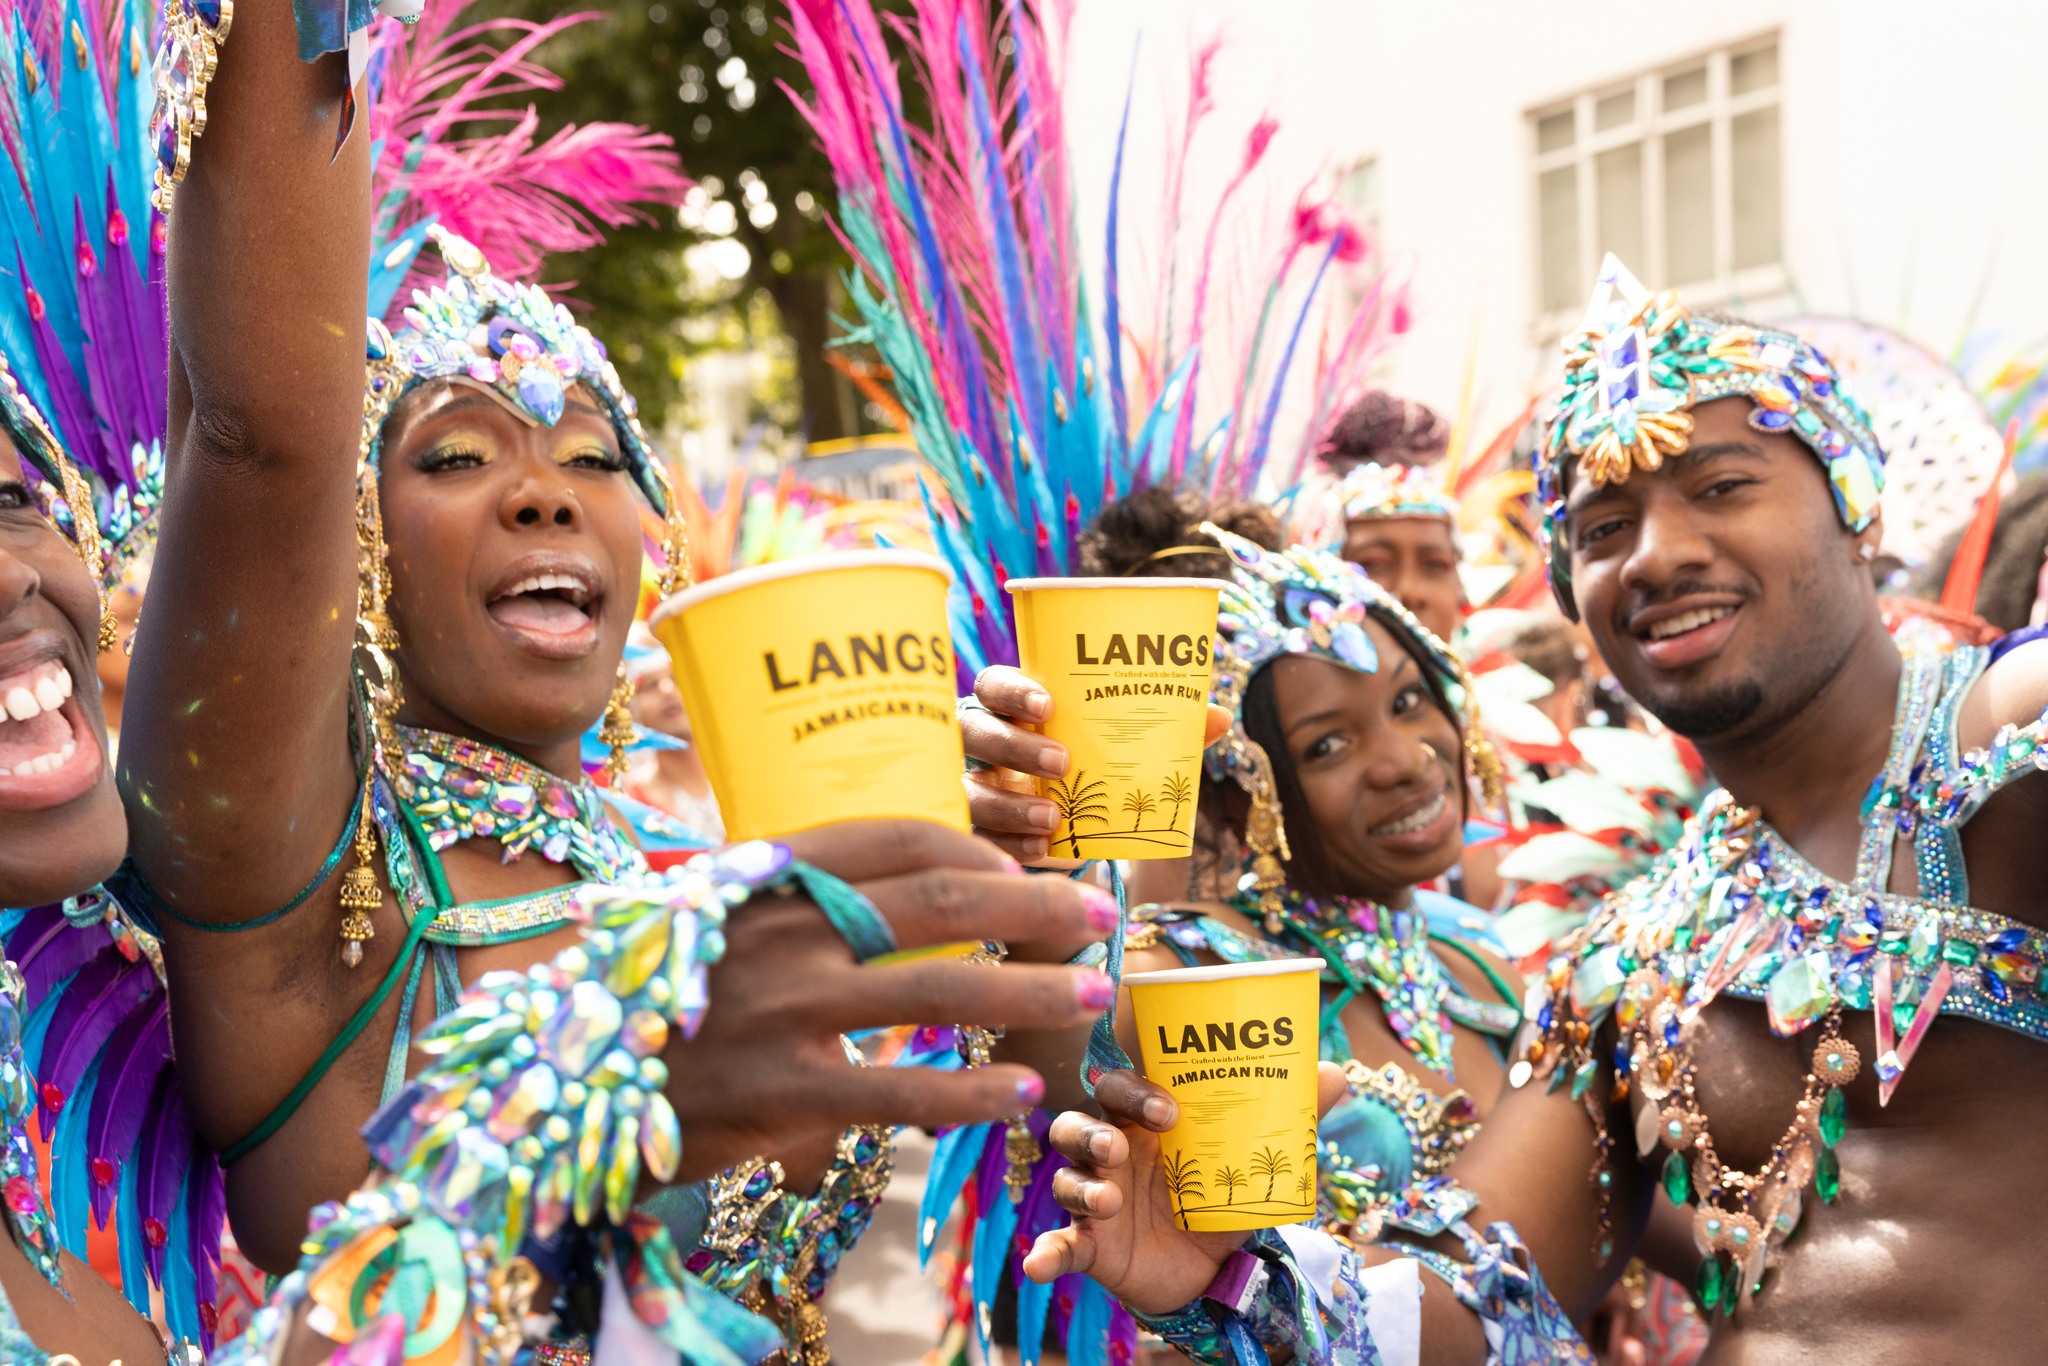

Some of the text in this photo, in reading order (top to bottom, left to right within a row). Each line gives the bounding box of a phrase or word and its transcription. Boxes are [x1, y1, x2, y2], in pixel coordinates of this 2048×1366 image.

[764, 633, 947, 692] LANGS
[1076, 633, 1209, 667] LANGS
[1114, 671, 1143, 679] Crafted
[1143, 671, 1160, 679] with
[1160, 671, 1171, 679] the
[1085, 683, 1202, 703] JAMAICAN RUM
[793, 700, 913, 742] JAMAICAN
[1158, 1016, 1294, 1054] LANGS
[1190, 1057, 1216, 1065] Crafted
[1216, 1055, 1233, 1063] with
[1233, 1054, 1245, 1062] the
[1171, 1066, 1289, 1087] JAMAICAN RUM
